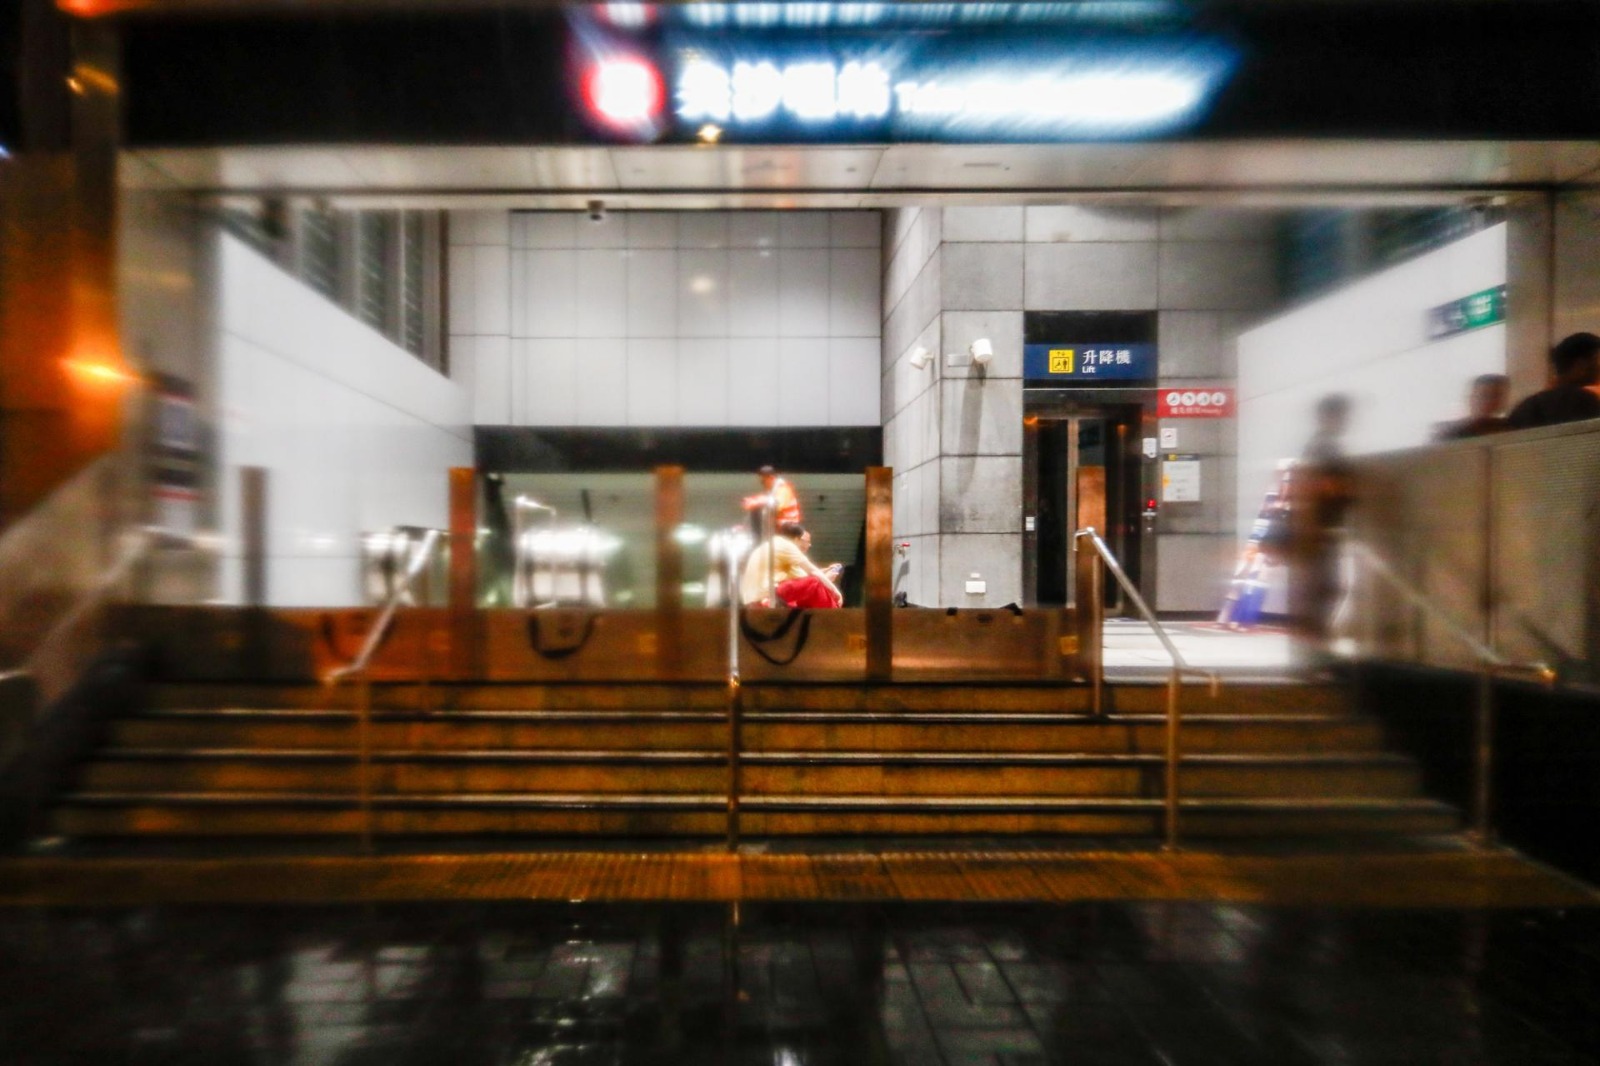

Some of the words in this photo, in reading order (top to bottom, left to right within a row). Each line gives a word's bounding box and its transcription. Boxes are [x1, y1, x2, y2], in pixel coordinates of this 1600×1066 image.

[1083, 350, 1132, 365] 升降機
[1082, 366, 1096, 374] Lift
